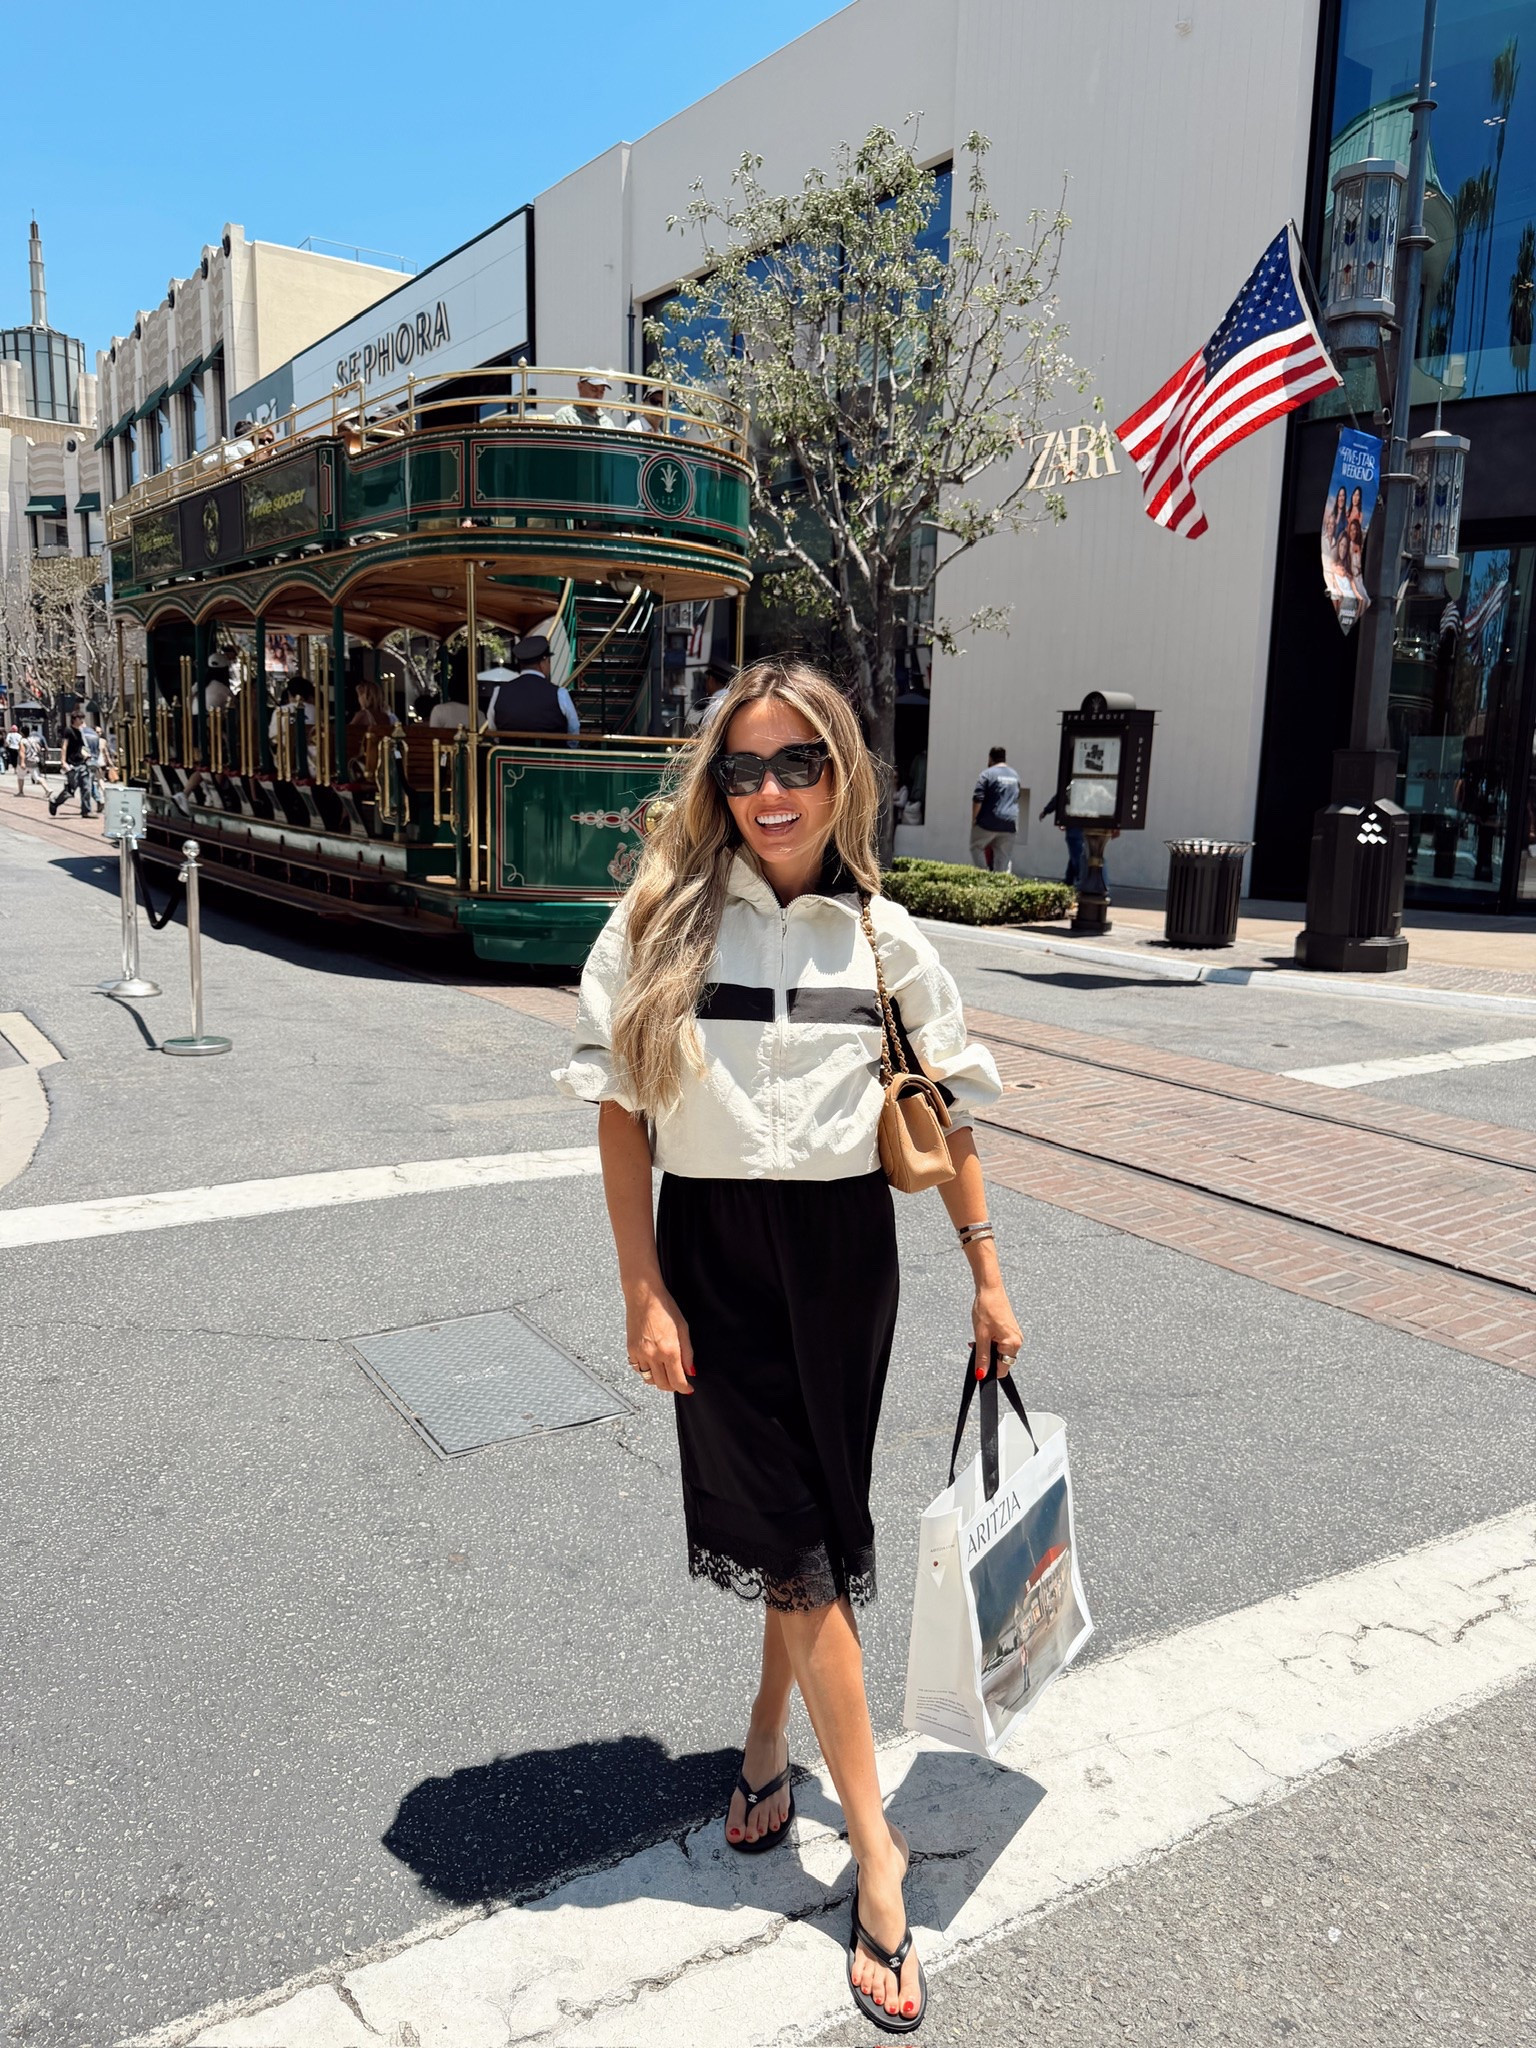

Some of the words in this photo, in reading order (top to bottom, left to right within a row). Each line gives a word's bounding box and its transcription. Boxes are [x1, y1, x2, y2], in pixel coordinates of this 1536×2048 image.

[337, 301, 450, 398] SEPHORA
[1026, 420, 1121, 490] ZARA
[967, 1490, 1021, 1562] ARITZIA
